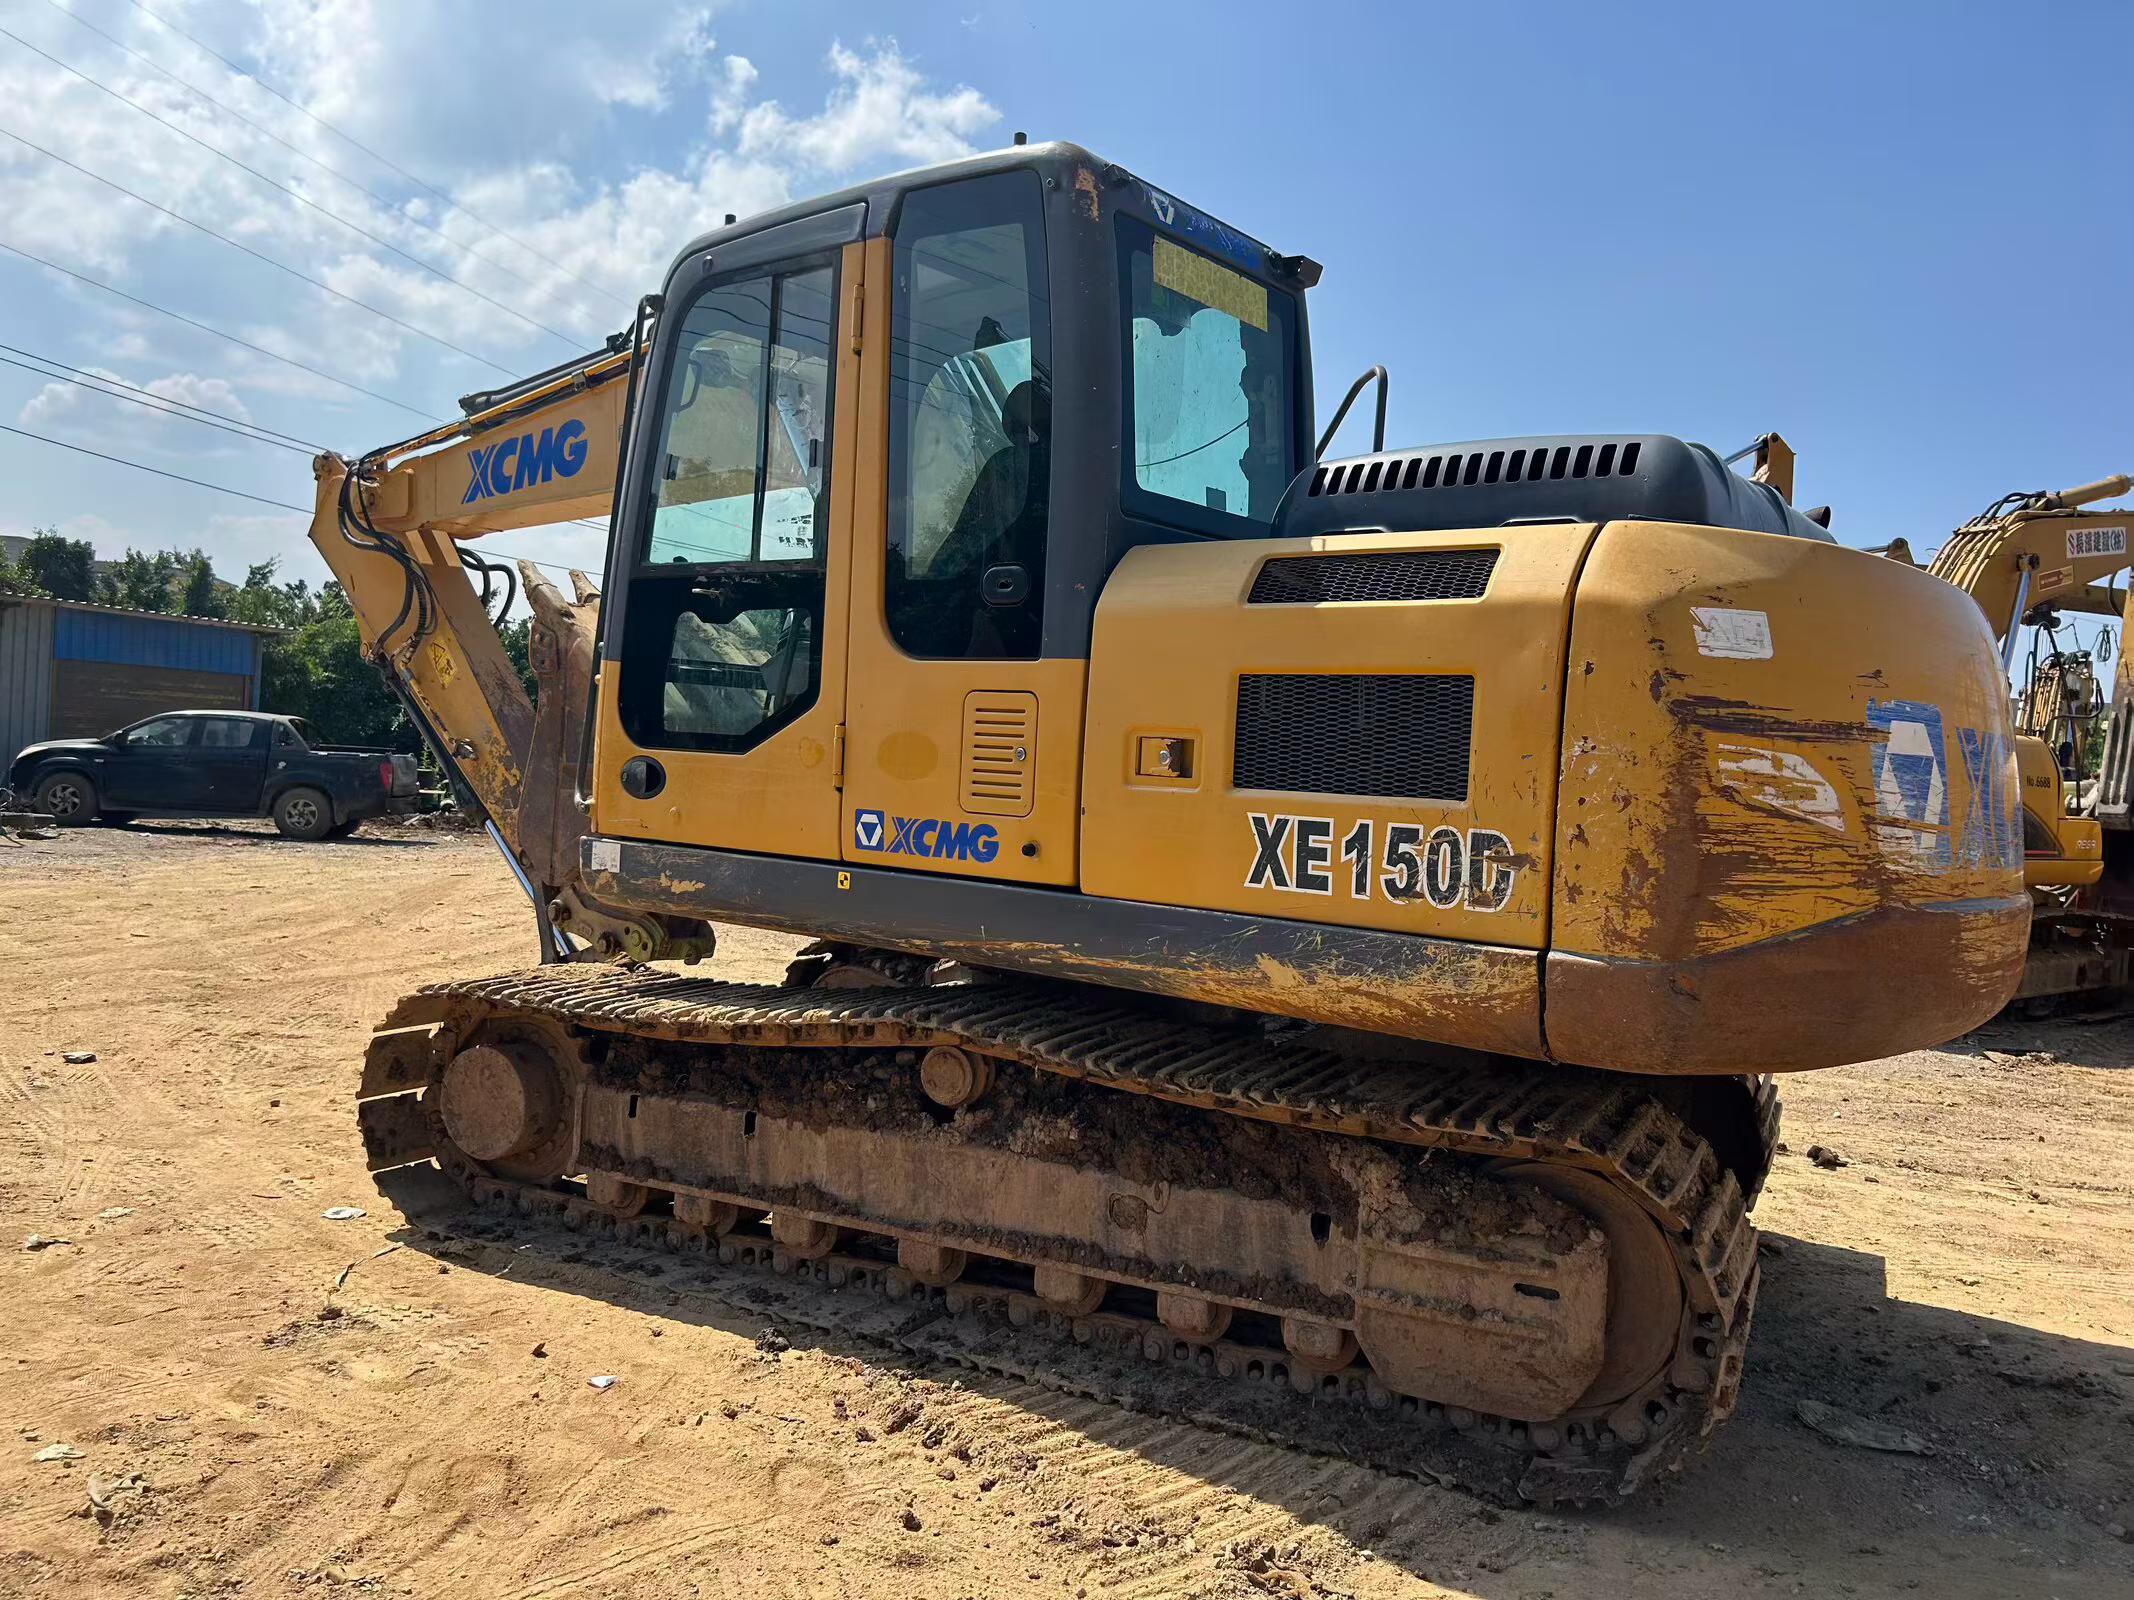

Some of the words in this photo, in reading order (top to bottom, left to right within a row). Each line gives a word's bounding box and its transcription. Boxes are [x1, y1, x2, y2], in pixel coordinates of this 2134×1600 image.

[461, 419, 588, 504] XCMG
[884, 816, 1000, 863] XCMG
[1244, 811, 1518, 912] XE150D
